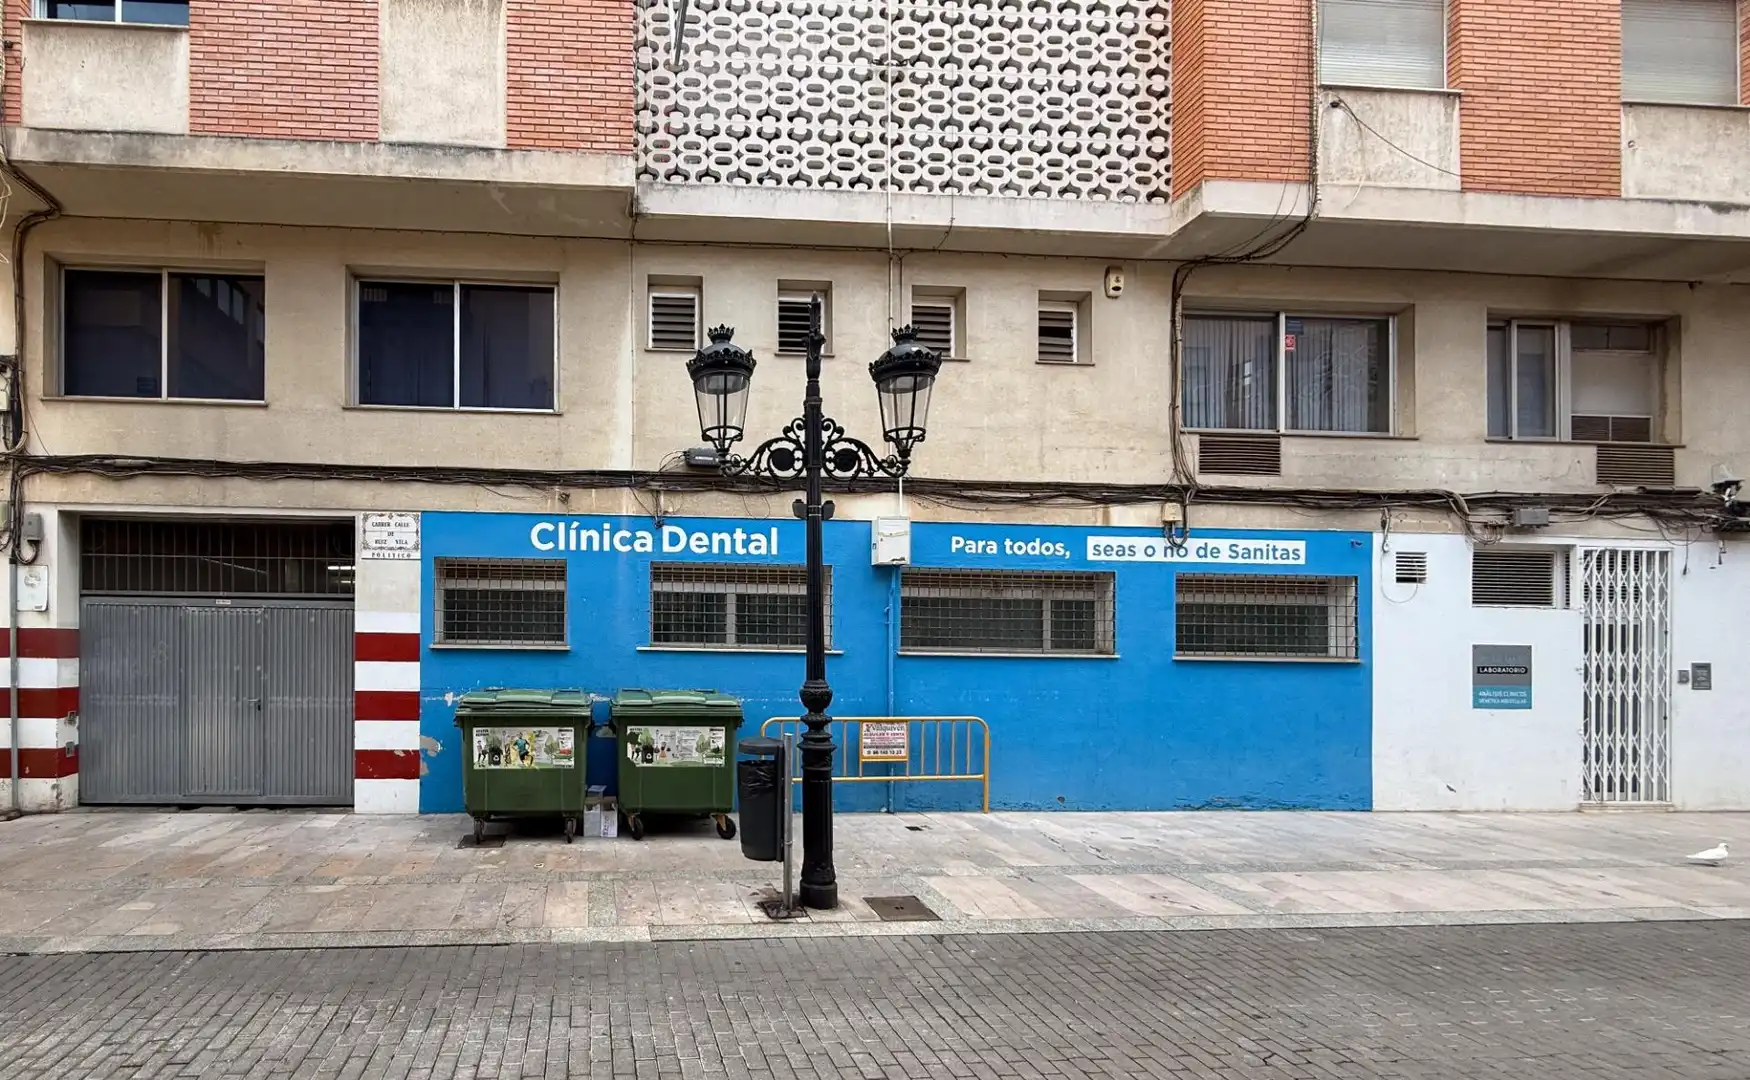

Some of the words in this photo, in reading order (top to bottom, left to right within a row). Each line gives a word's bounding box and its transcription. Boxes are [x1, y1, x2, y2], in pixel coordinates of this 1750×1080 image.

[530, 521, 656, 552] Clínica
[662, 525, 778, 555] Dental
[951, 536, 998, 554] Para
[1004, 538, 1070, 559] todos,
[1092, 544, 1136, 557] seas
[1144, 544, 1156, 558] o
[1164, 544, 1188, 558] no
[1196, 542, 1221, 559] de
[1228, 543, 1302, 560] Sanitas
